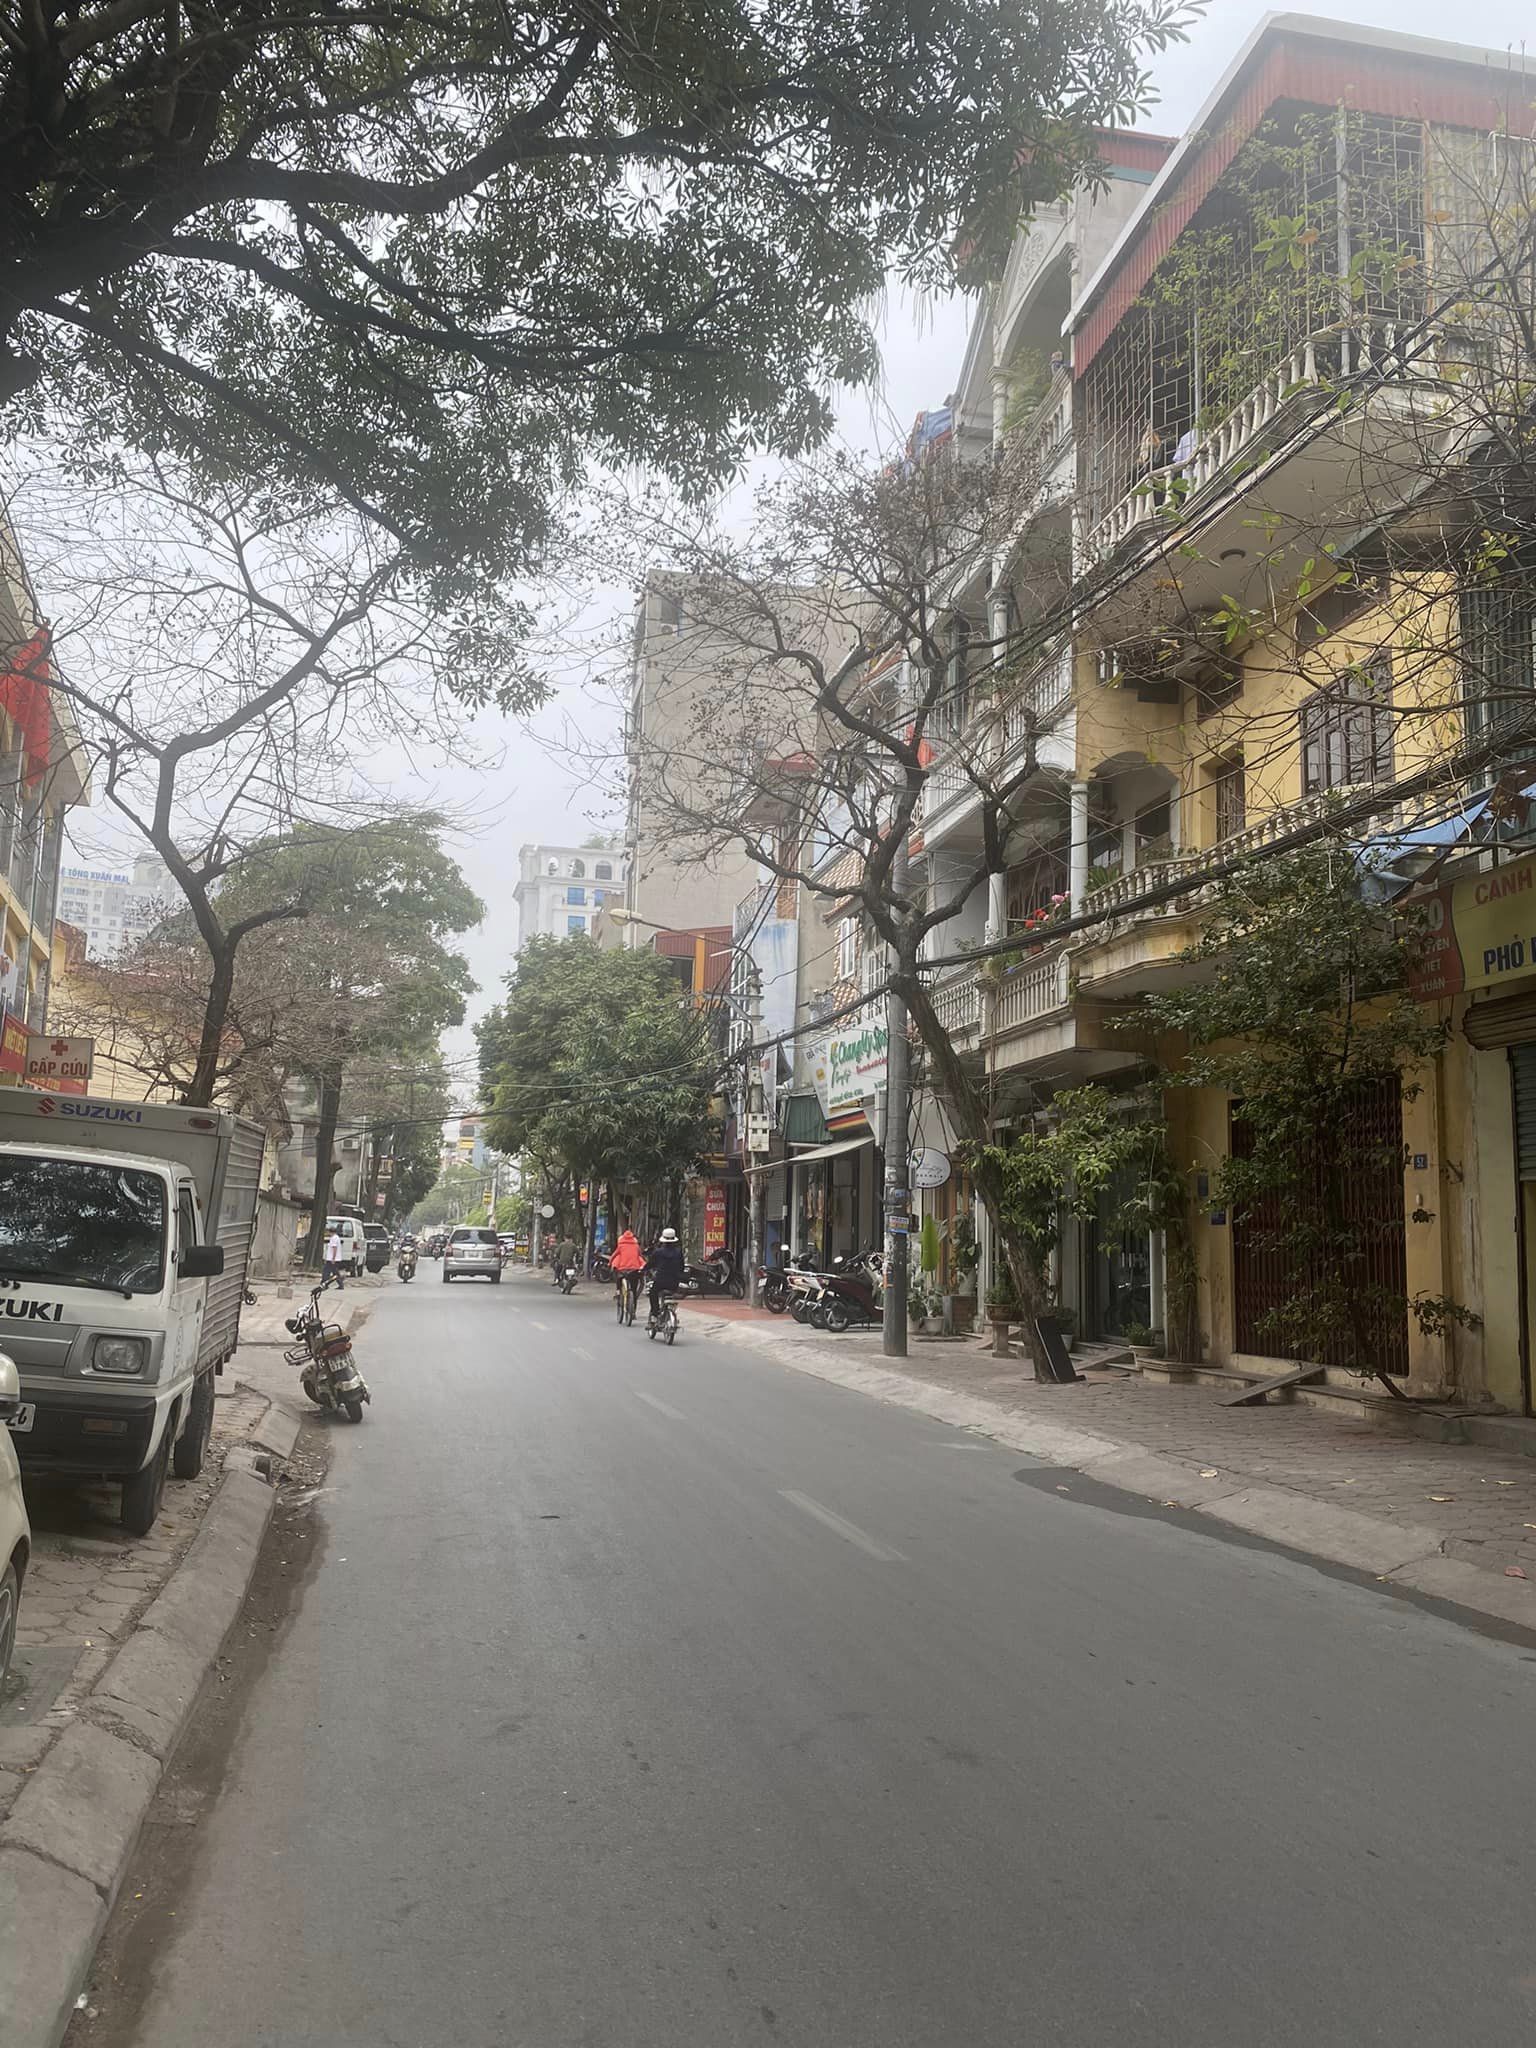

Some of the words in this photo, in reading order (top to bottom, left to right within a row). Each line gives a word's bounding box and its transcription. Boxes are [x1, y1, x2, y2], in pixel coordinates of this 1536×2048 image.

[1475, 866, 1533, 905] CANH
[30, 1056, 56, 1076] CẤP
[60, 1058, 88, 1077] CỨU
[60, 1103, 142, 1123] SUZUKI
[0, 1298, 63, 1321] UKI
